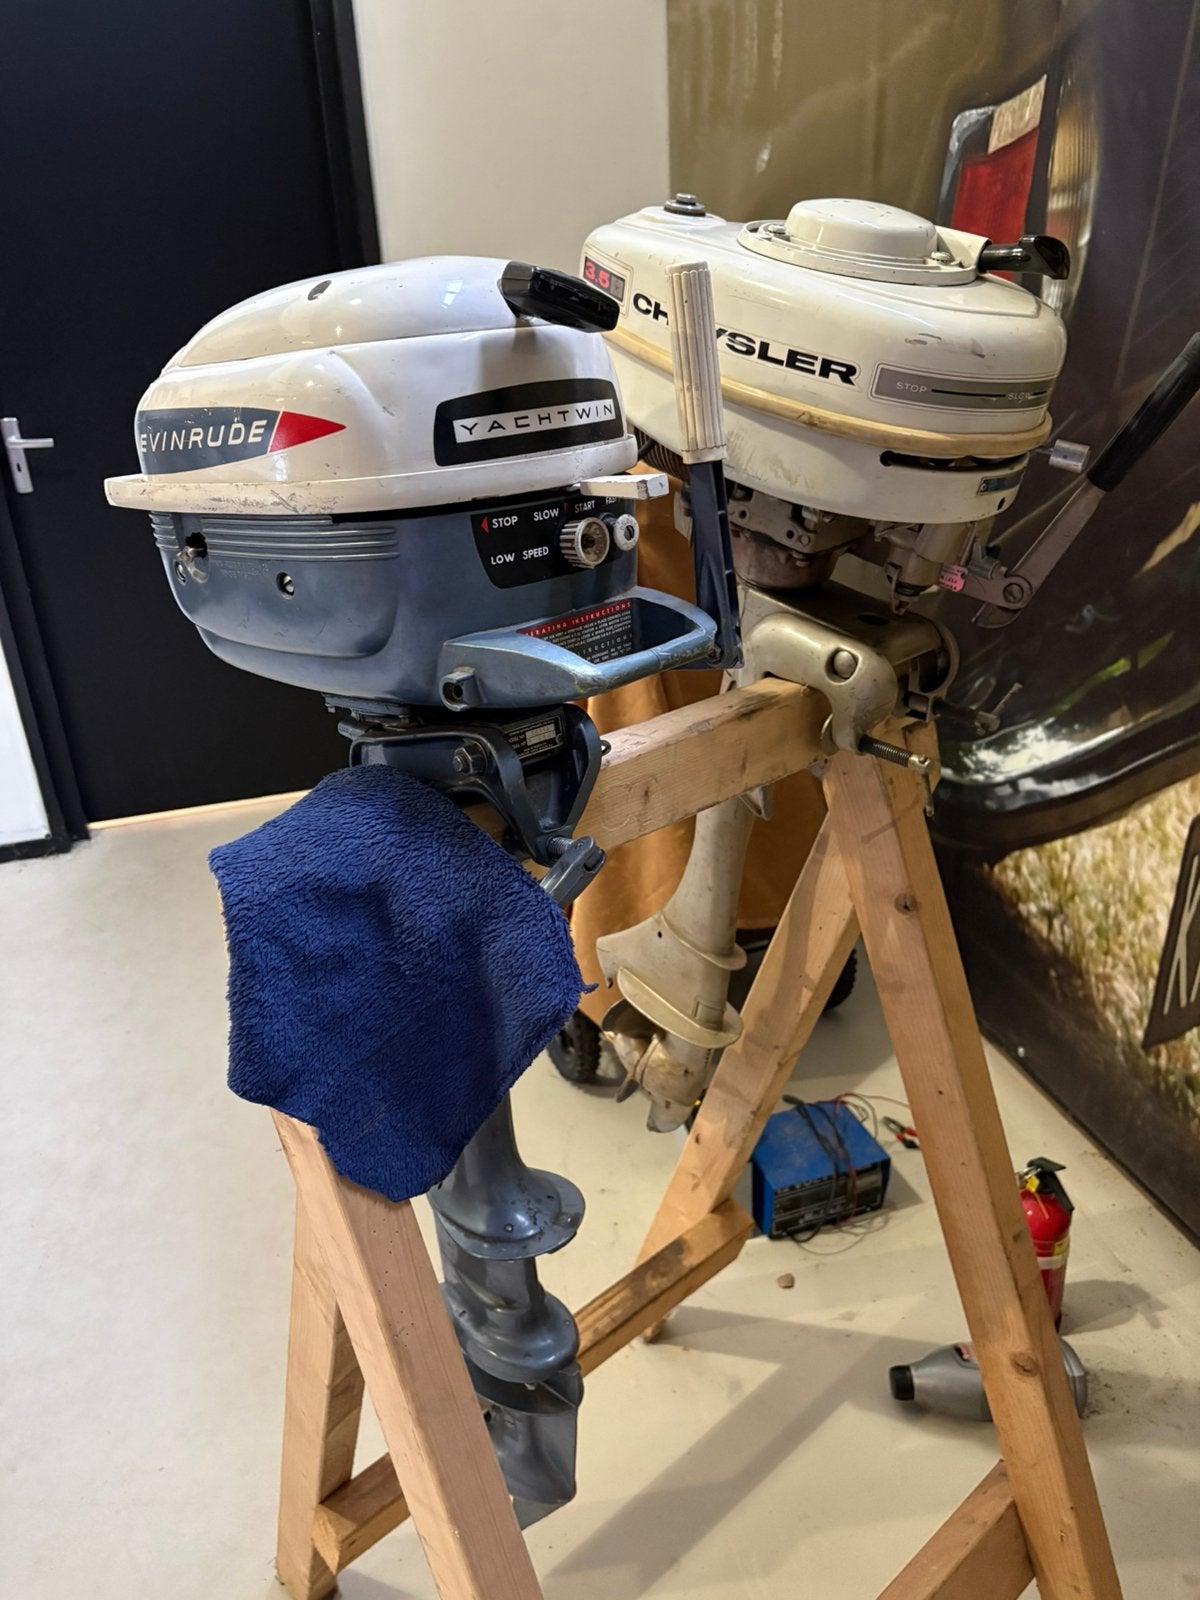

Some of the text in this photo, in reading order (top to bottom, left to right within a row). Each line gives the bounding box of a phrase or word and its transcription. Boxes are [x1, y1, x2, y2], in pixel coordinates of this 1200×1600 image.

[584, 261, 610, 289] 3.5
[633, 292, 858, 386] CHSLER
[896, 381, 928, 394] STOP
[460, 403, 612, 436] YACHTWIN
[140, 419, 268, 453] EVINRUDE
[492, 515, 519, 529] STOP
[533, 507, 560, 522] SLOW
[574, 500, 596, 514] START
[490, 545, 549, 565] LOW SPEED
[525, 621, 567, 637] ERATING
[571, 601, 632, 625] INSTRUCTIONS
